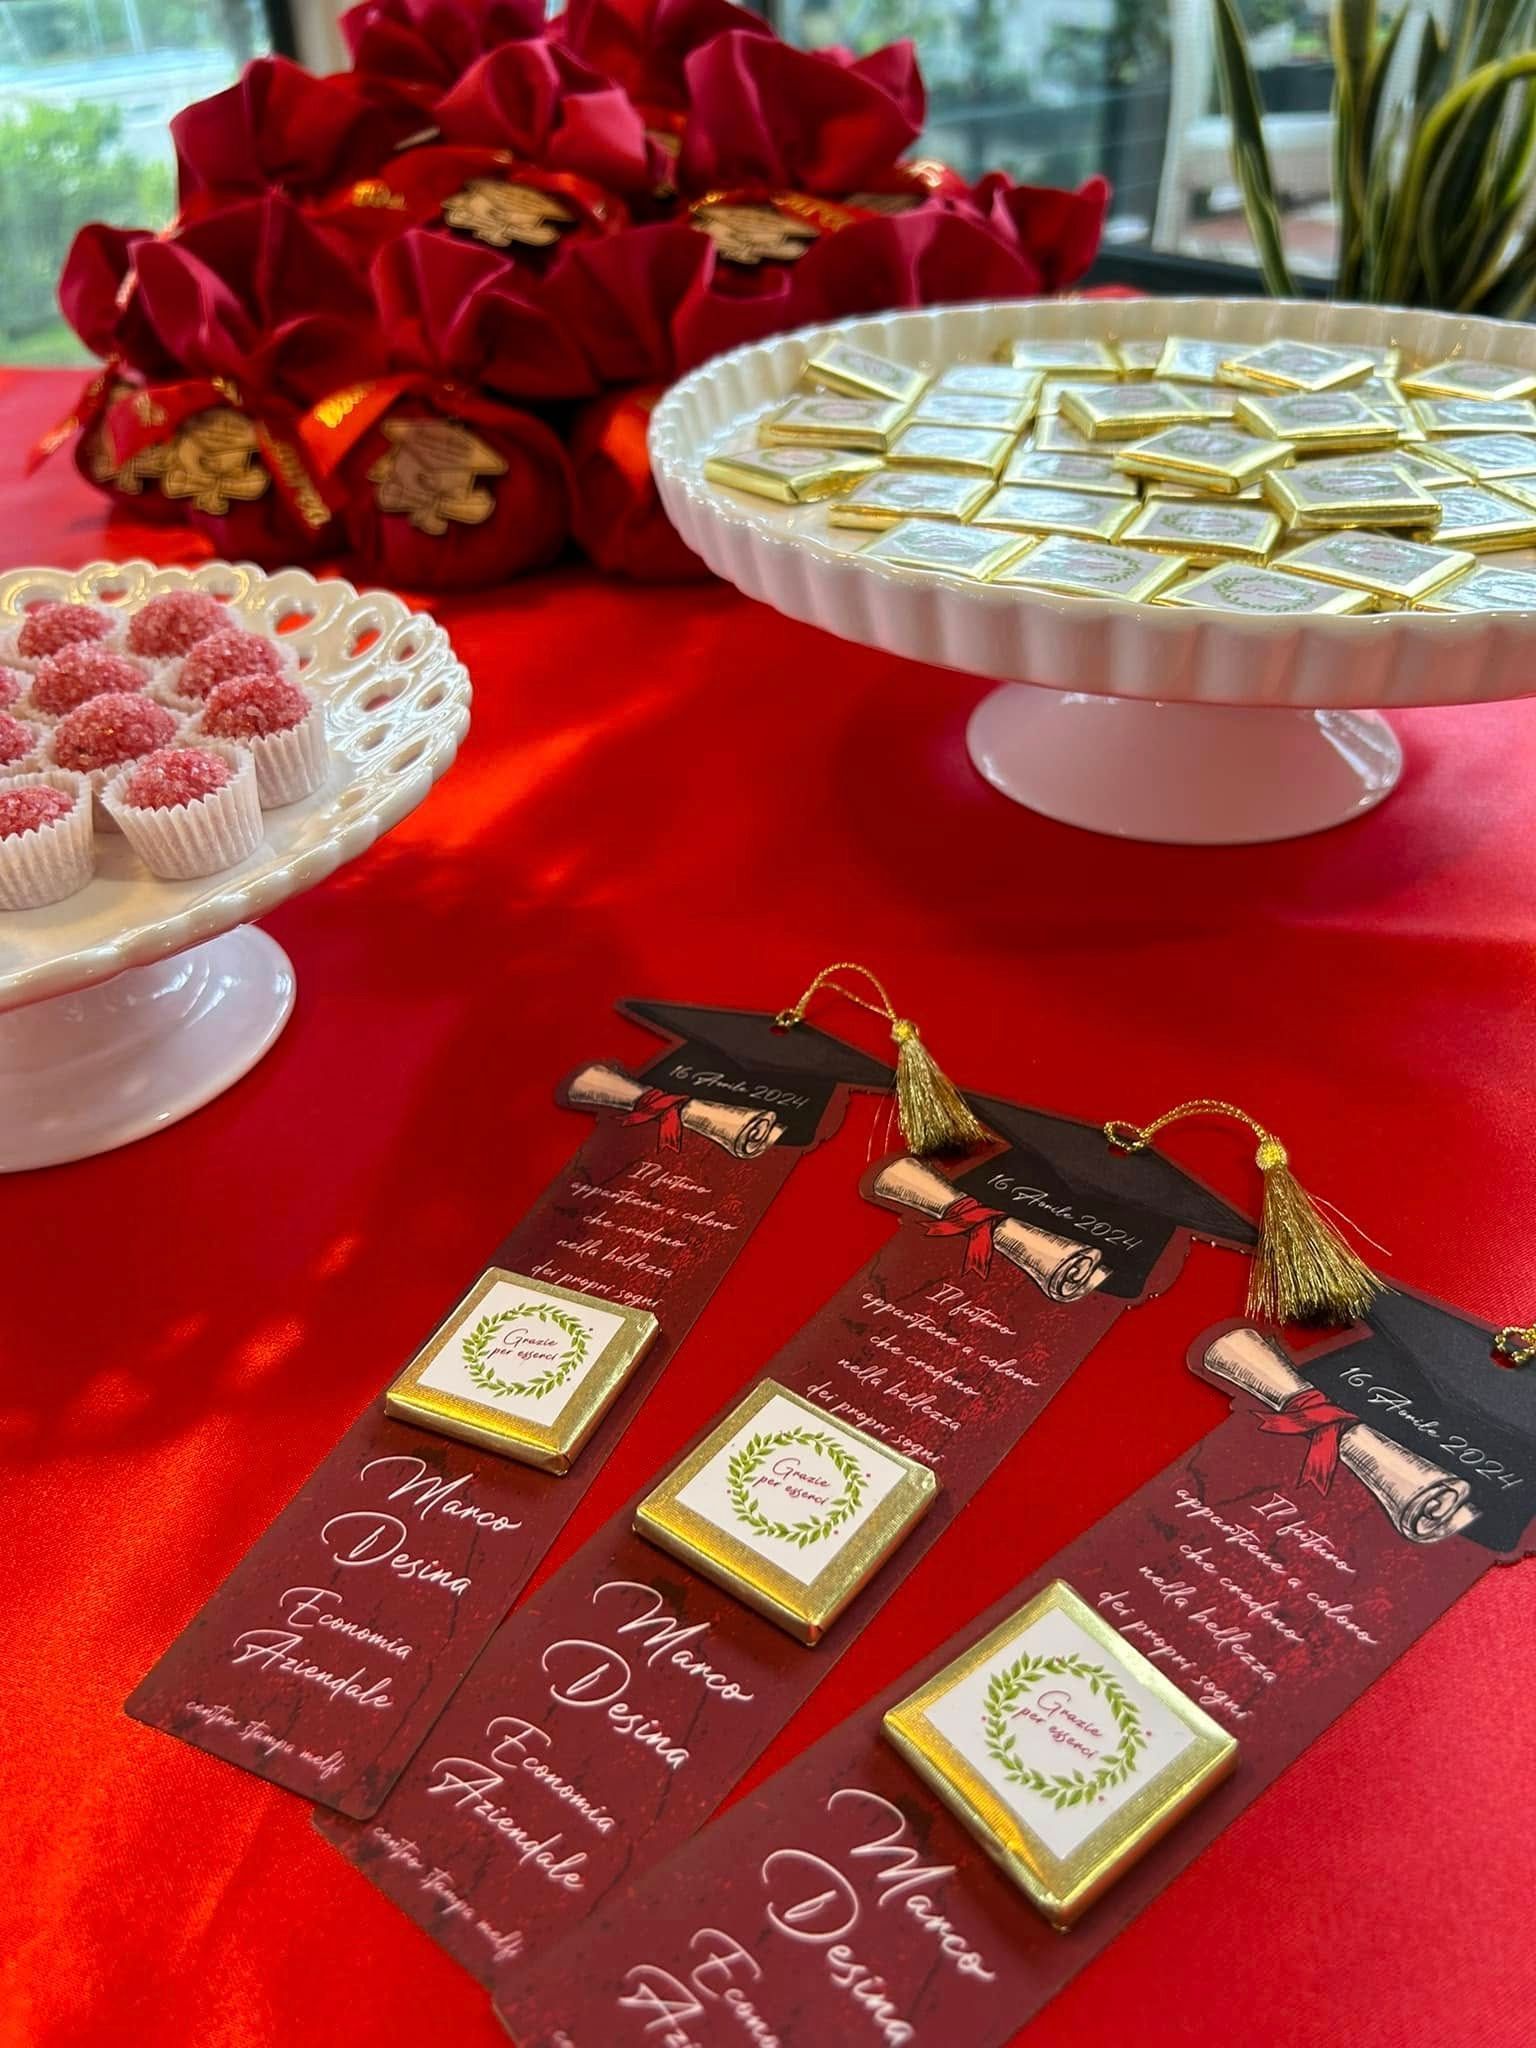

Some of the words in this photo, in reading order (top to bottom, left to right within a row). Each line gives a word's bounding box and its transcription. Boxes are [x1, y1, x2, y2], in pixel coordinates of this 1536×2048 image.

[669, 1064, 693, 1080] 16
[749, 1085, 810, 1109] 2024
[570, 1179, 665, 1212] appartiene
[666, 1207, 676, 1215] a
[681, 1207, 738, 1231] coloro
[626, 1161, 656, 1179] Il
[650, 1163, 712, 1194] futuro
[987, 1174, 1015, 1190] 16
[1074, 1215, 1143, 1250] 2024
[556, 1238, 598, 1258] nella
[602, 1247, 673, 1279] bellezza
[584, 1213, 616, 1229] che
[618, 1222, 686, 1248] credono
[532, 1262, 556, 1277] dei
[557, 1272, 616, 1294] propri
[614, 1288, 663, 1308] sogni
[925, 1283, 954, 1302] Il
[951, 1292, 1016, 1336] futuro
[487, 1344, 512, 1360] per
[517, 1350, 559, 1361] esserci
[503, 1328, 558, 1346] Grazie
[861, 1288, 962, 1347] appartiene
[962, 1345, 973, 1356] a
[979, 1353, 1040, 1388] coloro
[870, 1333, 905, 1357] che
[905, 1350, 980, 1397] credono
[807, 1381, 838, 1403] dei
[829, 1400, 896, 1436] propri
[891, 1433, 945, 1464] sogni
[838, 1357, 882, 1388] nella
[883, 1382, 962, 1433] bellezza
[1339, 1367, 1374, 1387] 16
[1439, 1435, 1524, 1489] 2024
[361, 1456, 522, 1532] Marco
[752, 1474, 780, 1488] per
[785, 1485, 830, 1506] esserci
[772, 1458, 831, 1488] Grazie
[321, 1511, 472, 1596] Desina
[1176, 1488, 1288, 1575] appartiene
[1288, 1576, 1301, 1588] a
[1307, 1591, 1378, 1646] coloro
[1251, 1492, 1287, 1520] Il
[1277, 1520, 1357, 1574] futuro
[280, 1587, 414, 1661] Economia
[1138, 1563, 1188, 1609] nella
[1188, 1606, 1278, 1684] bellezza
[1179, 1541, 1218, 1574] che
[1219, 1575, 1305, 1643] credono
[232, 1629, 393, 1709] Aziendale
[593, 1581, 754, 1702] Marco
[1097, 1590, 1136, 1617] dei
[1120, 1617, 1198, 1672] propri
[1190, 1674, 1254, 1720] sogni
[185, 1701, 240, 1725] centro
[239, 1719, 296, 1756] stampa
[299, 1750, 346, 1780] melfi
[541, 1639, 690, 1770] Desina
[1010, 1705, 1044, 1724] per
[1048, 1724, 1097, 1759] esserci
[1037, 1690, 1103, 1738] Grazie
[486, 1716, 615, 1833] Economia
[427, 1757, 587, 1889] Aziendale
[373, 1827, 423, 1870] centro
[421, 1866, 476, 1919] stampa
[476, 1918, 525, 1962] melfi
[826, 1787, 997, 1983] Marco
[761, 1848, 915, 2046] Desina
